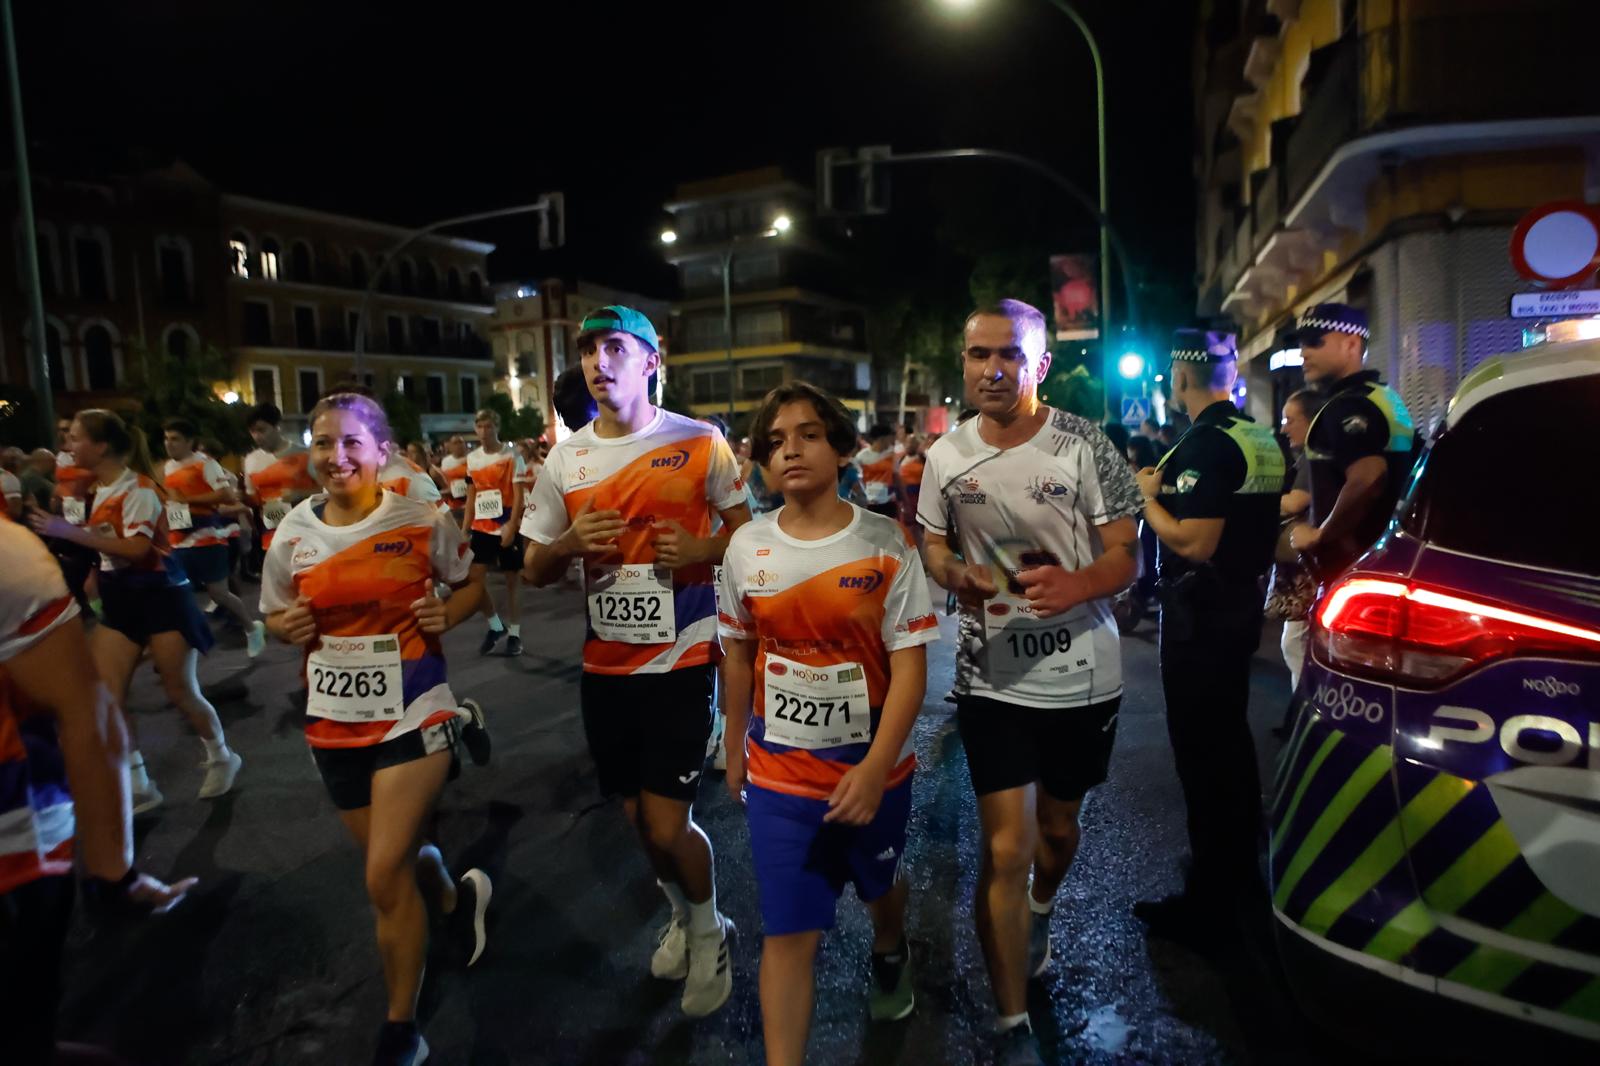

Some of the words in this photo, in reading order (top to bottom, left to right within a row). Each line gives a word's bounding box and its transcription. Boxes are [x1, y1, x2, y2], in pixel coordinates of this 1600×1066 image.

[595, 594, 662, 622] 12352
[1007, 628, 1072, 658] 1009
[314, 668, 387, 698] 22263
[775, 693, 850, 727] 22271
